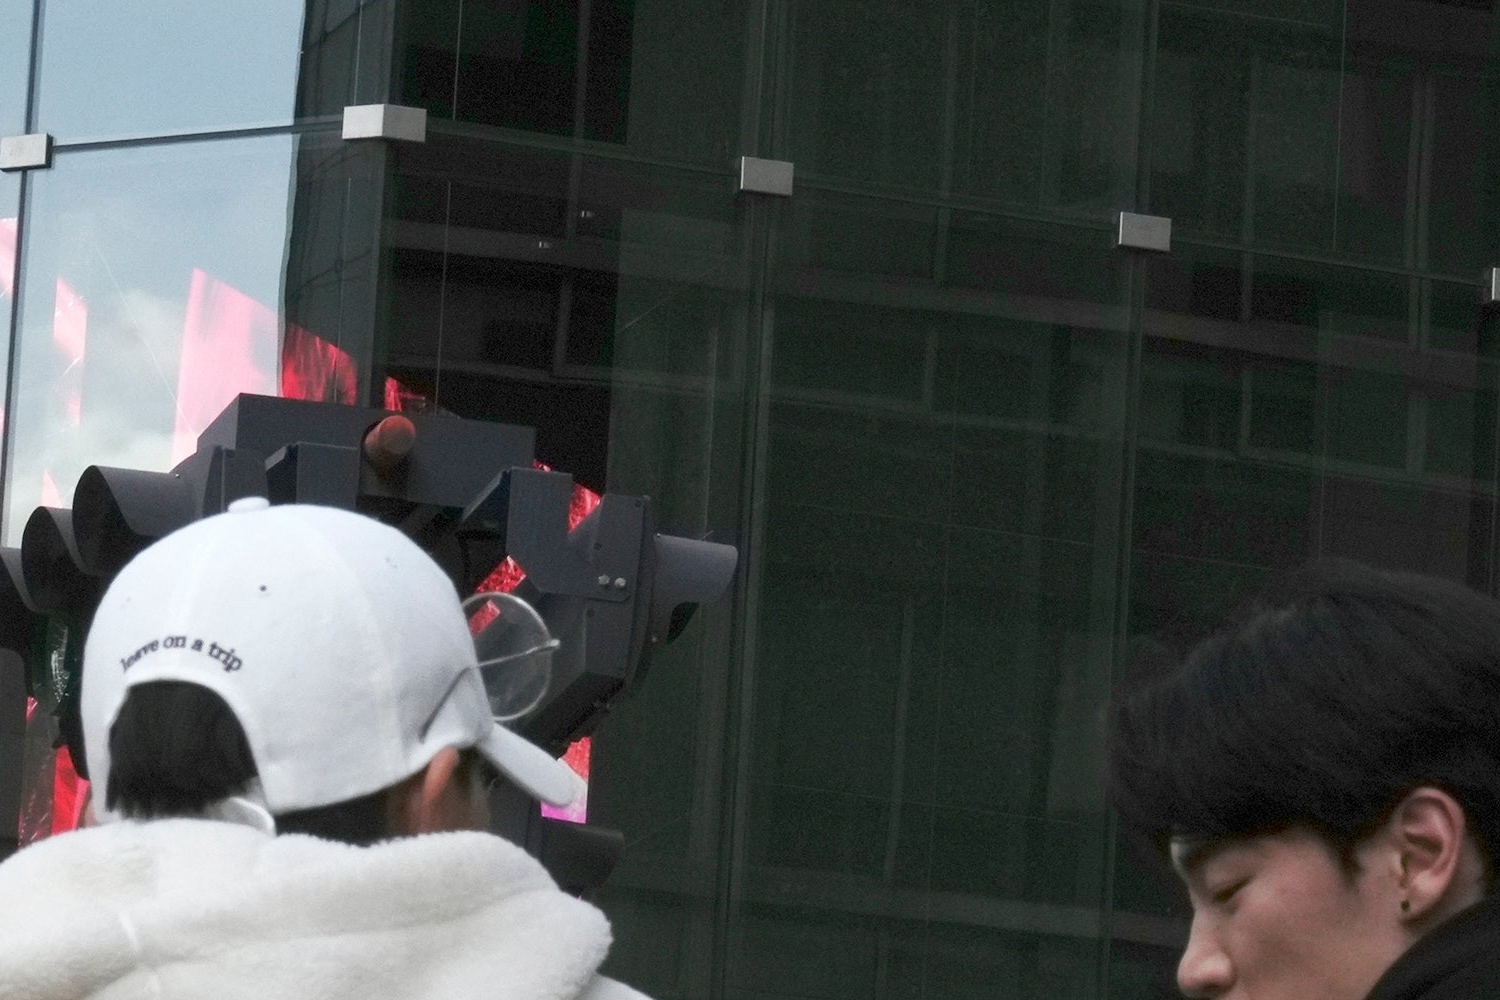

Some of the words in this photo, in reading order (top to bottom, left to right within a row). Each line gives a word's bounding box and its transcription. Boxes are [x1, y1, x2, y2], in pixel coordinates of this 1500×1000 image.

[163, 635, 187, 648] on
[191, 638, 204, 652] a
[208, 642, 243, 672] trip
